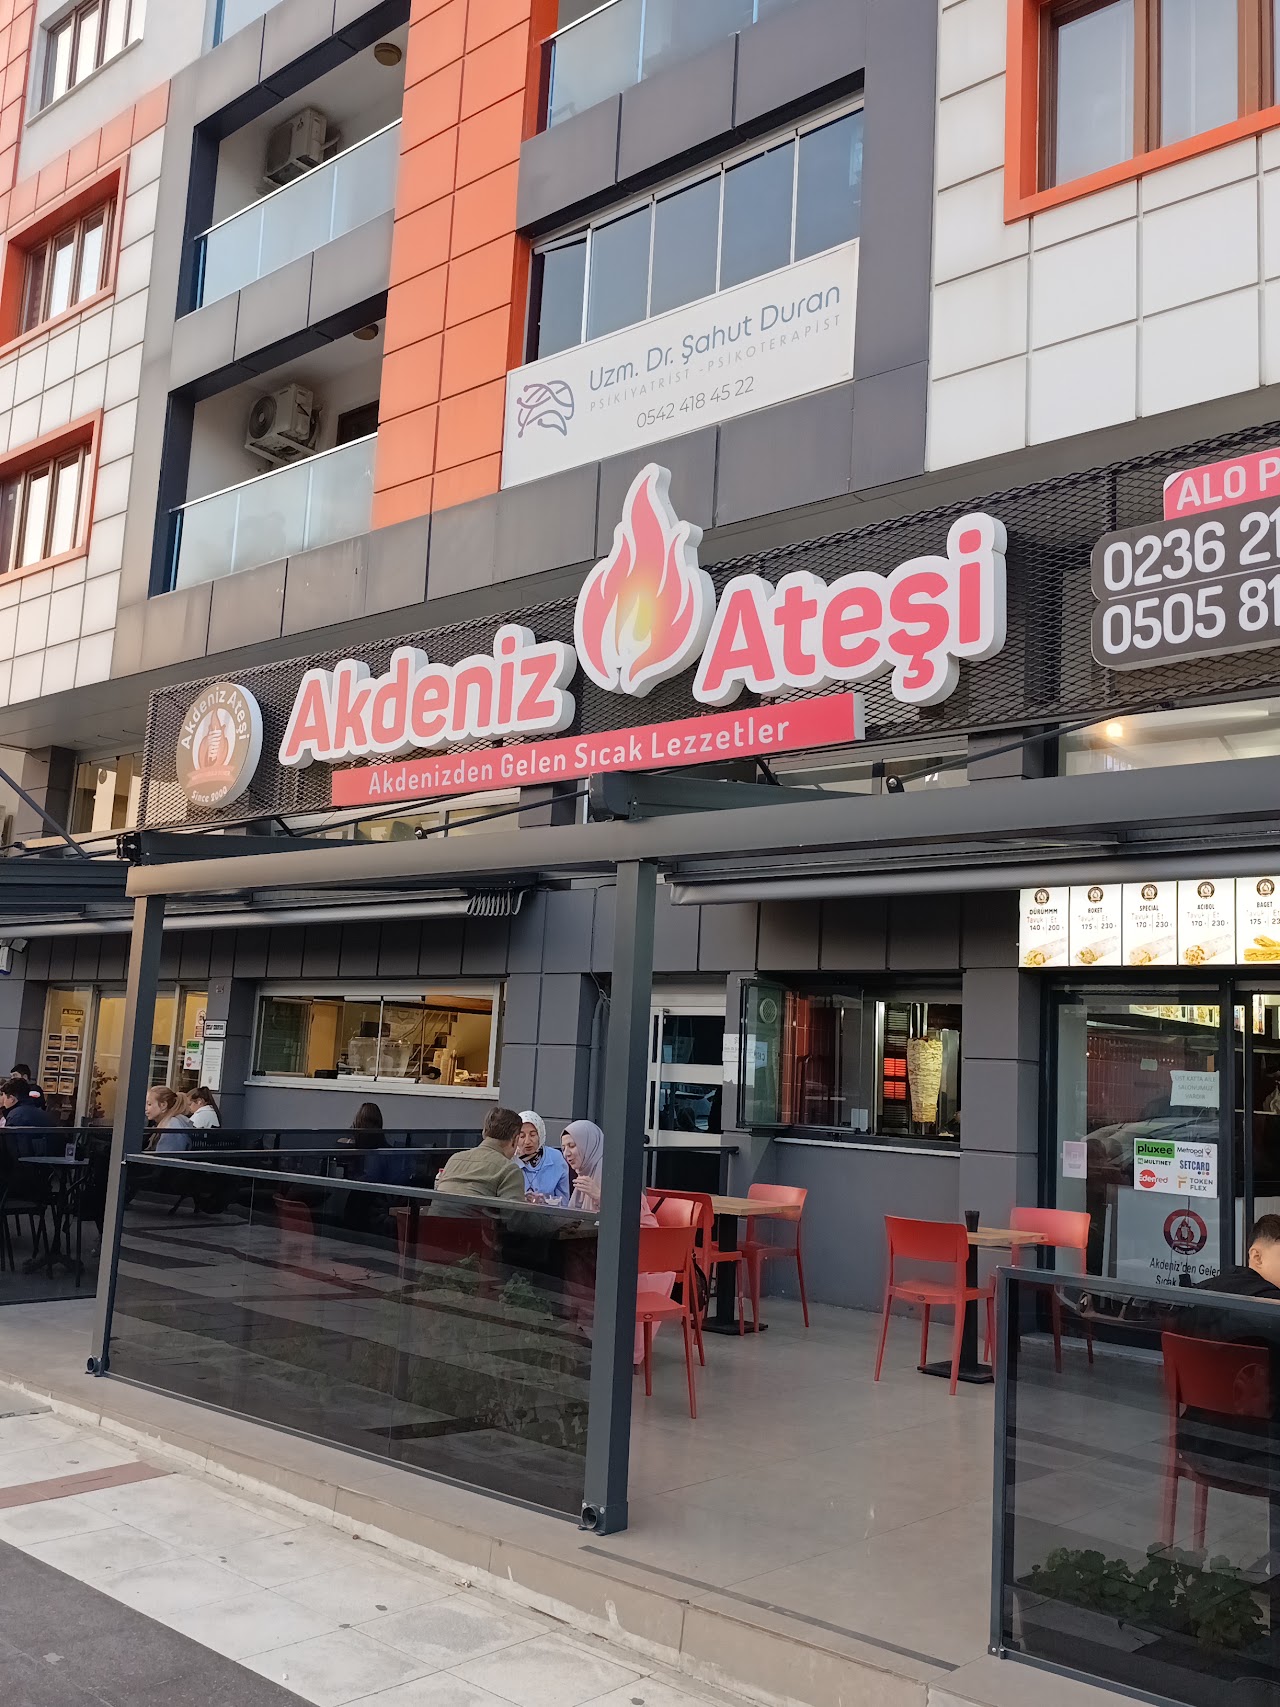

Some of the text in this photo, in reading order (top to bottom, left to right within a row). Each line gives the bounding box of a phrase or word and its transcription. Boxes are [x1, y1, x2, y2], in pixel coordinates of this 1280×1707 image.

[589, 286, 840, 391] Uzm. Dr. Şahut Duran
[636, 376, 754, 428] 0542 418 45 22
[1175, 464, 1247, 511] ALO
[1103, 521, 1226, 592] 0236
[282, 527, 983, 759] Akdeniz Ateşi
[1102, 585, 1227, 655] 0505
[181, 687, 250, 750] Akdeniz Ateşi
[368, 716, 790, 796] Akdenizden Gelen Sıcak Lezzetler
[191, 785, 228, 803] Since 2000
[1137, 1143, 1173, 1155] pluxee
[1143, 1158, 1172, 1166] MULTINET
[1176, 1147, 1204, 1155] Metropol
[1179, 1160, 1210, 1171] SETCARD
[1189, 1177, 1213, 1185] TOKEN
[1189, 1184, 1207, 1192] FLEX
